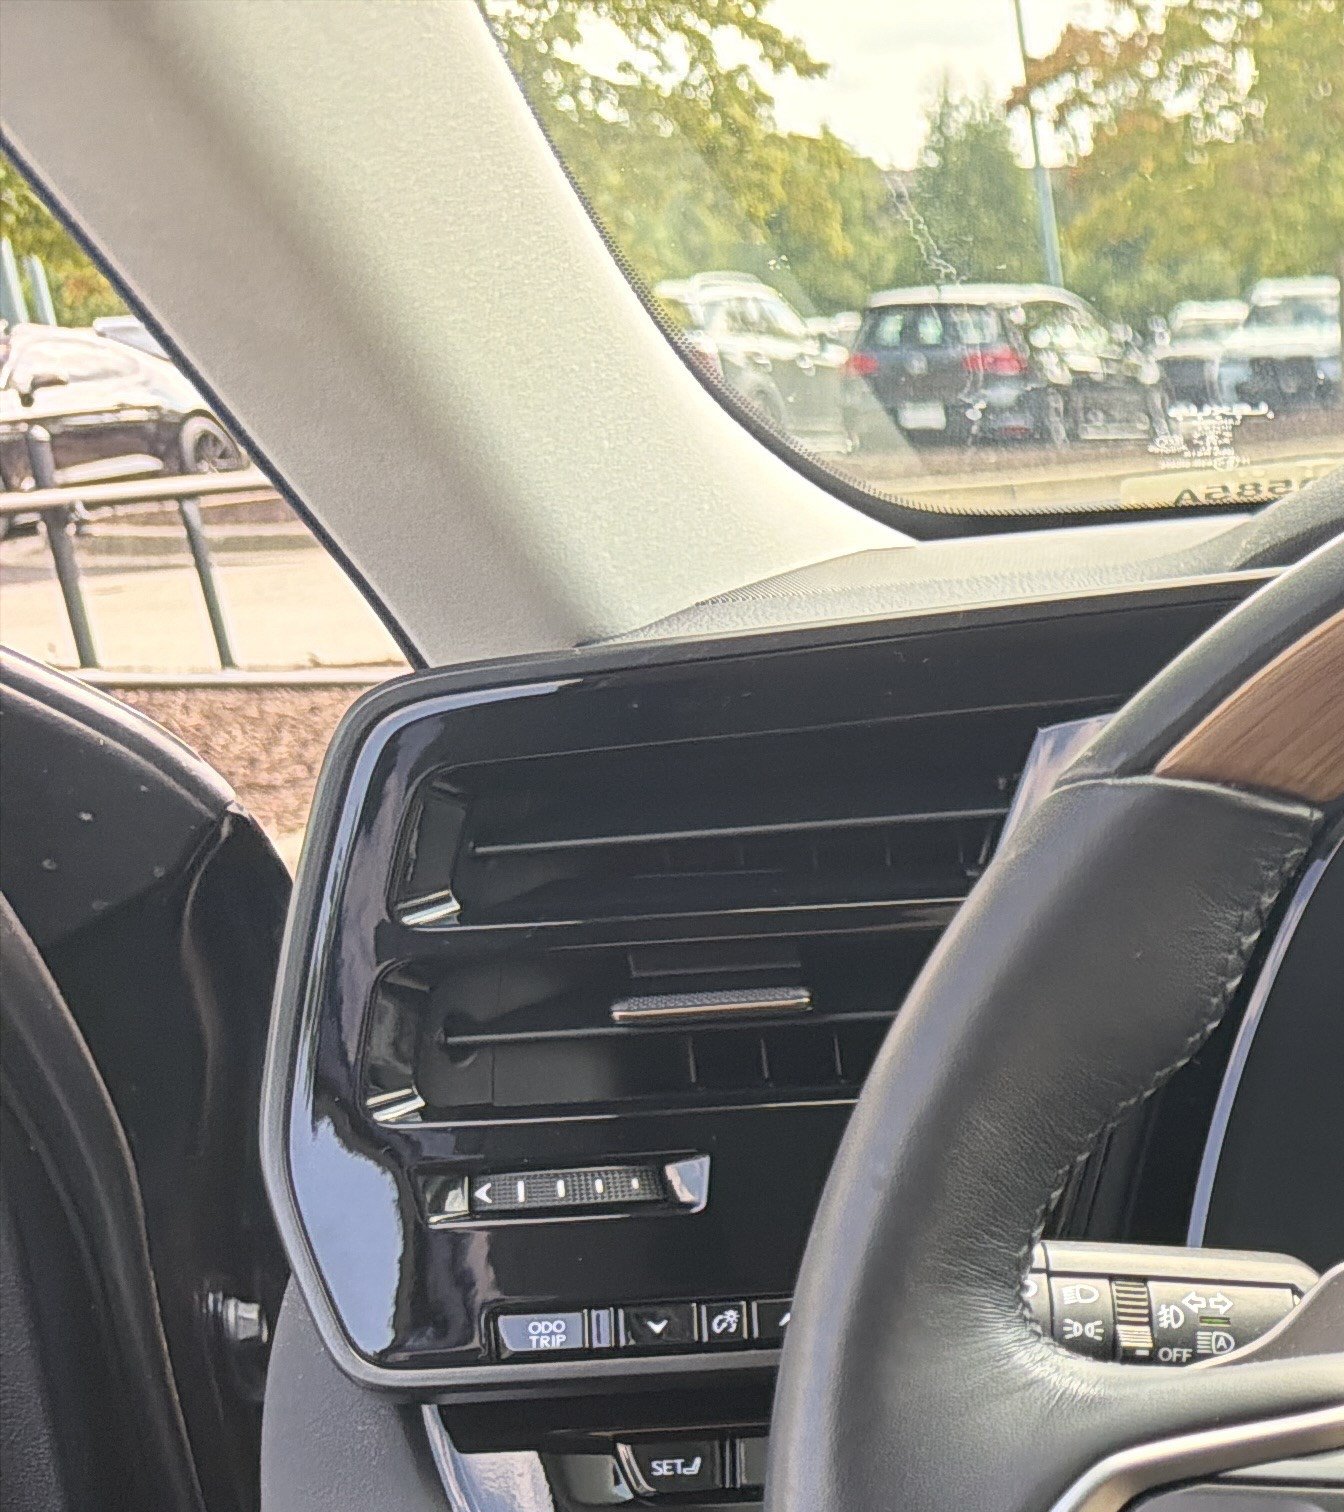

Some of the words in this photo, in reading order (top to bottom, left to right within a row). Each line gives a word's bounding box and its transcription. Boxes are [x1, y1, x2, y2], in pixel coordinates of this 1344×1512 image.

[528, 1320, 566, 1335] ODO
[529, 1334, 566, 1349] TRIP
[1159, 1347, 1193, 1362] OFF
[651, 1459, 684, 1476] SET
